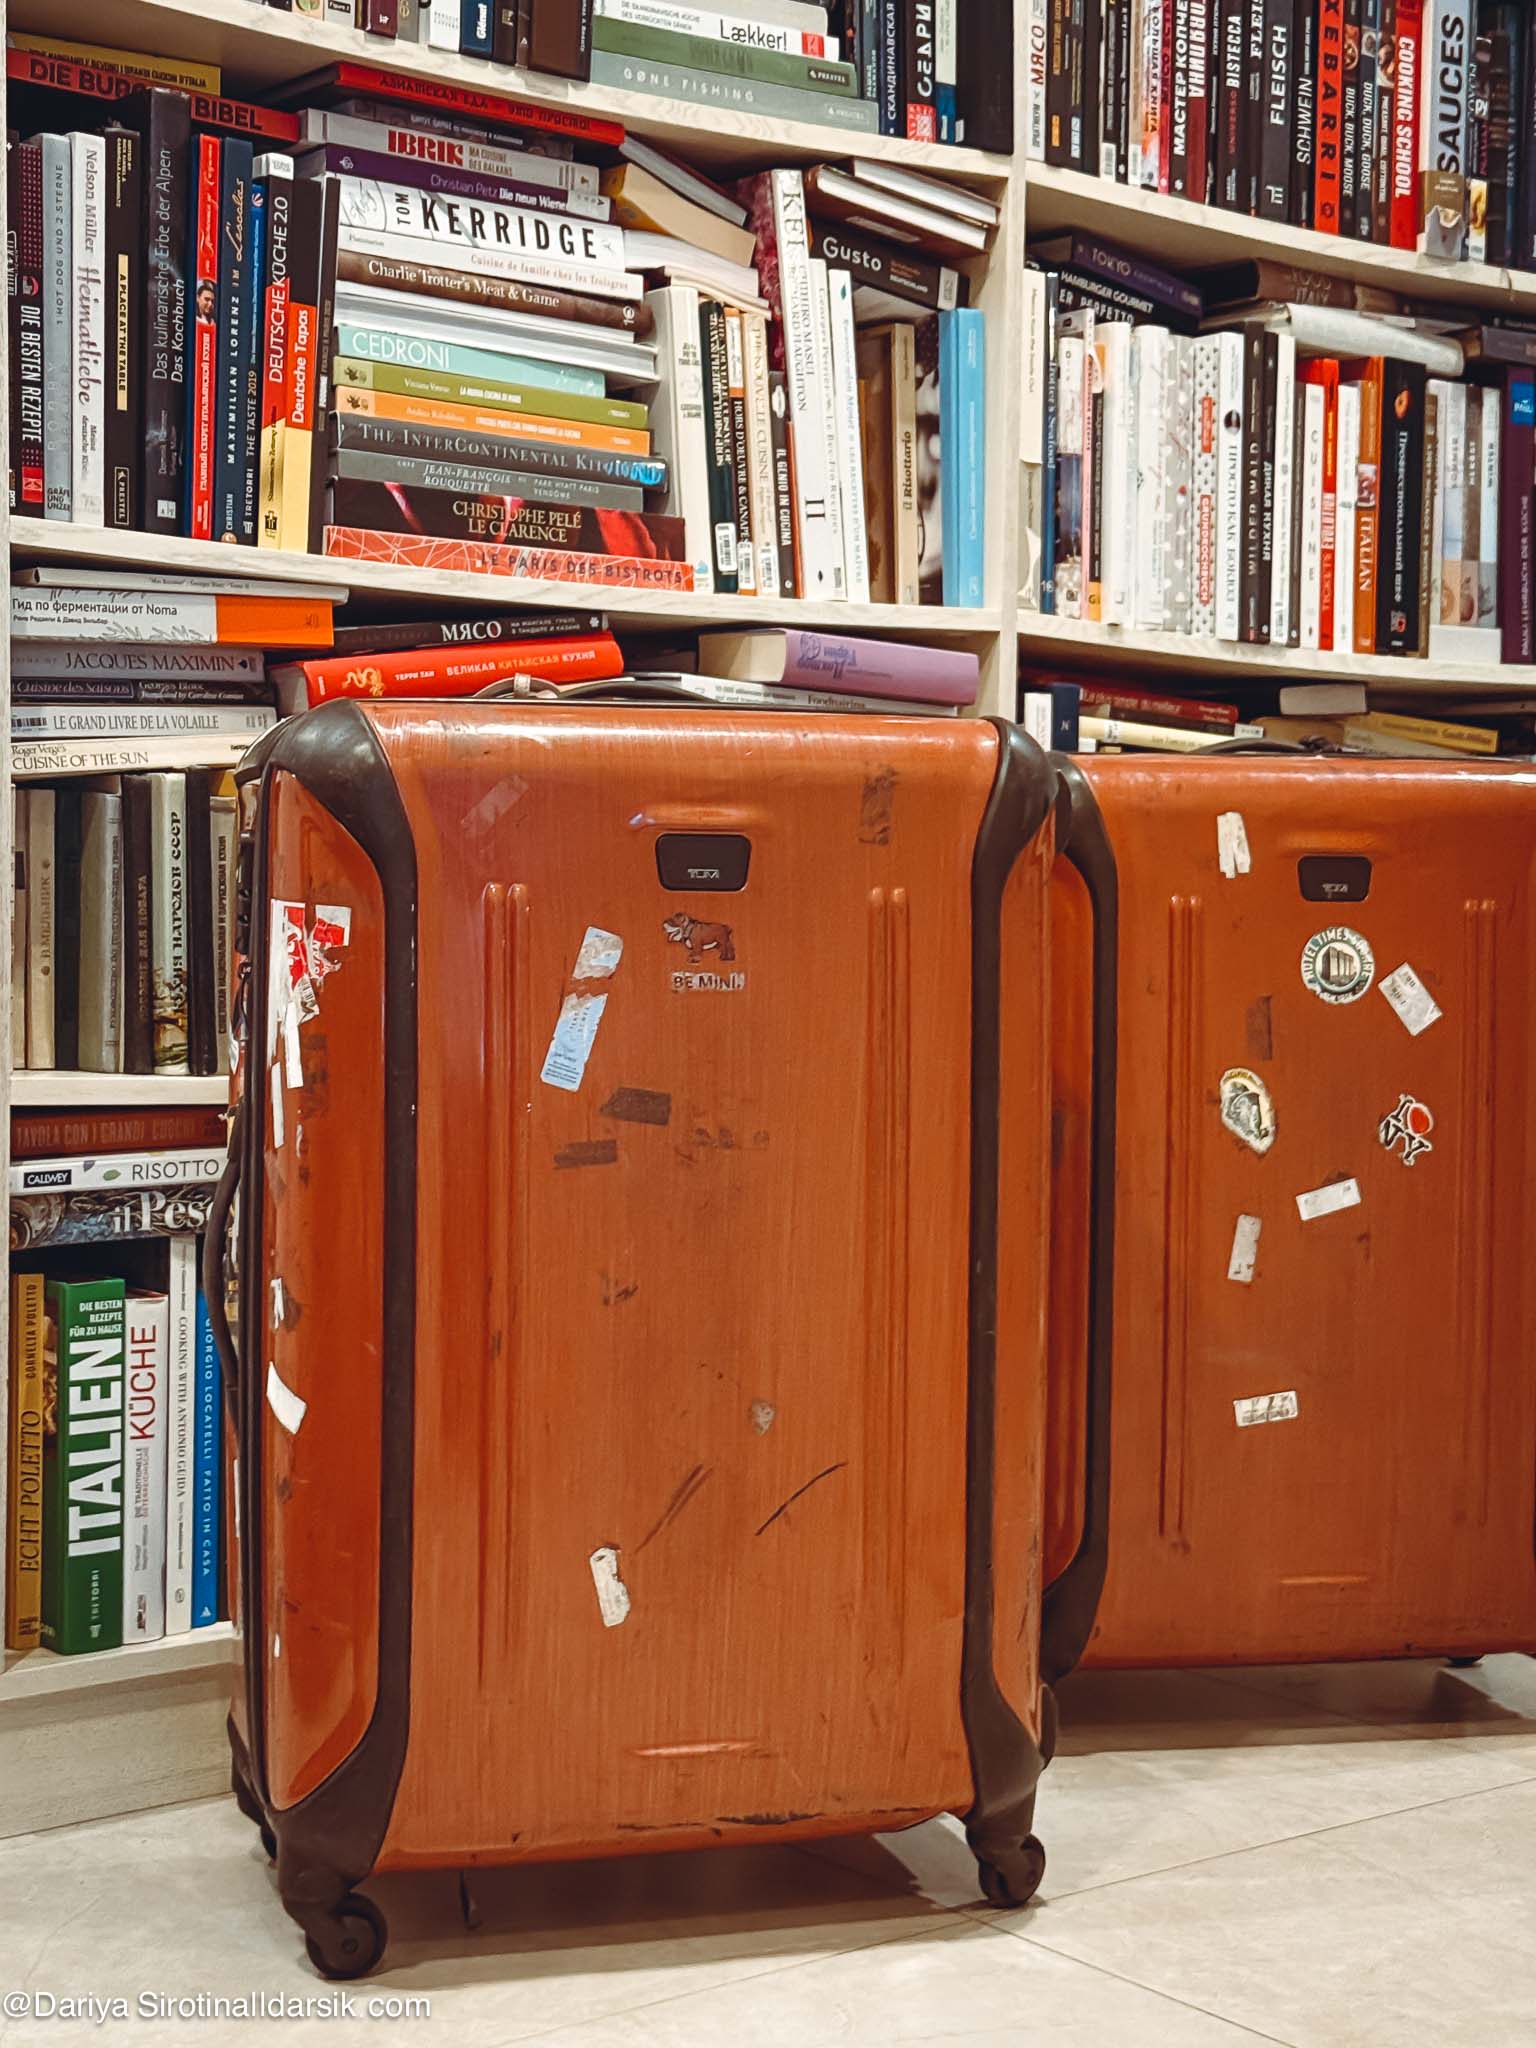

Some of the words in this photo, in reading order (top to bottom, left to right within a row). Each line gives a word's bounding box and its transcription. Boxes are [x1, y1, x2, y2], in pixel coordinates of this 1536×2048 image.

[476, 3, 488, 40] Glénat
[719, 19, 787, 51] Lækker!
[886, 2, 898, 121] СКАНДИНАВСКАЯ
[1030, 25, 1046, 86] МЯСО
[1225, 15, 1242, 88] BISTECCA
[29, 58, 72, 87] DIE
[193, 99, 264, 131] BIBEL
[680, 78, 755, 102] FISHING
[1270, 25, 1288, 126] FLEISCH
[1397, 36, 1416, 122] COOKING
[1437, 14, 1464, 174] SAUCES
[1173, 71, 1188, 156] МАСТЕР
[1296, 77, 1313, 165] SCHWEIN
[387, 129, 465, 167] IBRIK
[480, 147, 507, 164] CUISINE
[1394, 124, 1413, 199] SCHOOL
[85, 149, 98, 200] Nelson
[155, 149, 174, 193] Alpen
[483, 160, 514, 177] BALKANS
[1342, 157, 1353, 197] MOOSE
[1360, 153, 1371, 190] GOOSE
[56, 163, 64, 213] STERNE
[430, 173, 475, 195] Christian
[475, 181, 498, 197] Petz
[499, 186, 513, 200] Die
[514, 191, 538, 206] neue
[156, 197, 171, 220] der
[273, 196, 289, 222] 2.0
[394, 192, 411, 225] TOM
[422, 196, 598, 259] KERRIDGE
[783, 190, 806, 247] KEI
[56, 228, 64, 256] UND
[85, 204, 97, 252] Müller
[154, 223, 171, 258] Erbe
[56, 259, 64, 285] DOG
[271, 223, 288, 286] KÜCHE
[470, 253, 506, 270] Cuisine
[521, 258, 551, 277] famille
[552, 266, 573, 279] chez
[589, 271, 630, 291] Troisgros
[822, 236, 883, 272] Gusto
[1091, 247, 1132, 277] TOKYO
[119, 283, 128, 318] PLACE
[367, 260, 416, 284] Charlie
[417, 267, 472, 293] Trotter's
[473, 277, 506, 299] Meat
[508, 286, 520, 300] &
[521, 287, 561, 308] Game
[1060, 271, 1112, 303] HAMBURGER
[1112, 289, 1154, 314] GOURMET
[20, 305, 41, 329] DIE
[152, 261, 169, 350] kulinarische
[172, 279, 185, 350] Kochbuch
[75, 266, 102, 406] Heimatliebe
[229, 295, 240, 357] LORENZ
[269, 286, 286, 384] DEUTSCHE
[294, 309, 308, 353] Tapas
[20, 331, 41, 382] BESTEN
[118, 338, 128, 356] THE
[351, 331, 451, 369] CEDRONI
[804, 330, 816, 376] MASUI
[118, 357, 128, 392] TABLE
[152, 353, 168, 380] Das
[170, 355, 184, 382] Das
[248, 370, 257, 397] 2019
[291, 357, 307, 424] Deutsche
[21, 385, 43, 443] REZEPTE
[227, 366, 238, 464] MAXIMILIAN
[247, 398, 256, 436] TASTE
[733, 400, 743, 430] HORS
[246, 437, 255, 456] THE
[358, 423, 395, 444] THE
[755, 428, 769, 482] CUISINE
[776, 448, 787, 459] IL
[903, 430, 913, 498] Risottario
[1249, 442, 1260, 495] WALD
[422, 463, 512, 486] JEAN-FRANÇOIS
[424, 475, 491, 493] ROUQUETTE
[777, 462, 788, 492] GENIO
[452, 500, 546, 526] CHRISTOPHE
[548, 511, 582, 530] PELÉ
[778, 493, 790, 505] IN
[467, 518, 487, 535] LE
[488, 519, 569, 544] CLARENCE
[779, 507, 792, 547] CUCINA
[1226, 509, 1237, 542] КАК
[1248, 503, 1260, 576] WILDER
[1261, 510, 1272, 561] КУХНЯ
[480, 550, 498, 567] LE
[508, 554, 558, 573] PARIS
[566, 559, 597, 577] DES
[604, 564, 684, 584] BISTROTS
[1359, 515, 1376, 593] ITALIAN
[12, 599, 34, 614] Гид
[35, 601, 50, 613] по
[52, 600, 129, 617] ферментации
[146, 603, 178, 616] Noma
[440, 619, 502, 643] МЯСО
[65, 650, 149, 674] JACQUES
[151, 654, 236, 673] MAXIMIN
[446, 660, 497, 677] ВЕЛИКАЯ
[497, 654, 561, 671] КИТАЙСКАЯ
[561, 650, 597, 664] КУХНЯ
[53, 715, 67, 730] LE
[69, 715, 107, 730] GRAND
[109, 714, 139, 730] LIVRE
[140, 714, 155, 729] DE
[156, 715, 170, 729] LA
[170, 714, 220, 730] VOLAILLE
[12, 744, 36, 757] Roger
[12, 755, 69, 771] CUISINE
[69, 753, 89, 768] OF
[89, 753, 119, 767] THE
[119, 751, 150, 765] SUN
[171, 811, 185, 861] СССР
[170, 867, 186, 951] НАРОДОВ
[168, 955, 186, 1014] КУХНЯ
[673, 974, 695, 990] BE
[64, 1124, 90, 1145] CON
[100, 1120, 146, 1145] GRANDI
[27, 1172, 68, 1186] CALLWEY
[131, 1158, 220, 1182] RISOTTO
[112, 1205, 131, 1234] il
[26, 1284, 38, 1332] POLETTO
[79, 1301, 93, 1312] DIE
[94, 1299, 123, 1311] BESTEN
[89, 1311, 123, 1323] REZEPTE
[69, 1324, 85, 1338] FÜR
[86, 1325, 97, 1336] ZU
[97, 1323, 123, 1335] HAUSE
[177, 1316, 188, 1370] COOKING
[25, 1333, 38, 1380] CORNELIA
[128, 1324, 158, 1442] KÜCHE
[176, 1372, 187, 1404] WITH
[176, 1406, 186, 1459] ANTONIO
[203, 1386, 213, 1460] LOCATELLI
[19, 1410, 42, 1508] POLETTO
[68, 1337, 123, 1558] ITALIEN
[176, 1460, 186, 1498] GUIDA
[203, 1469, 212, 1512] FATTO
[18, 1515, 41, 1573] ECHT
[202, 1539, 211, 1576] CASA
